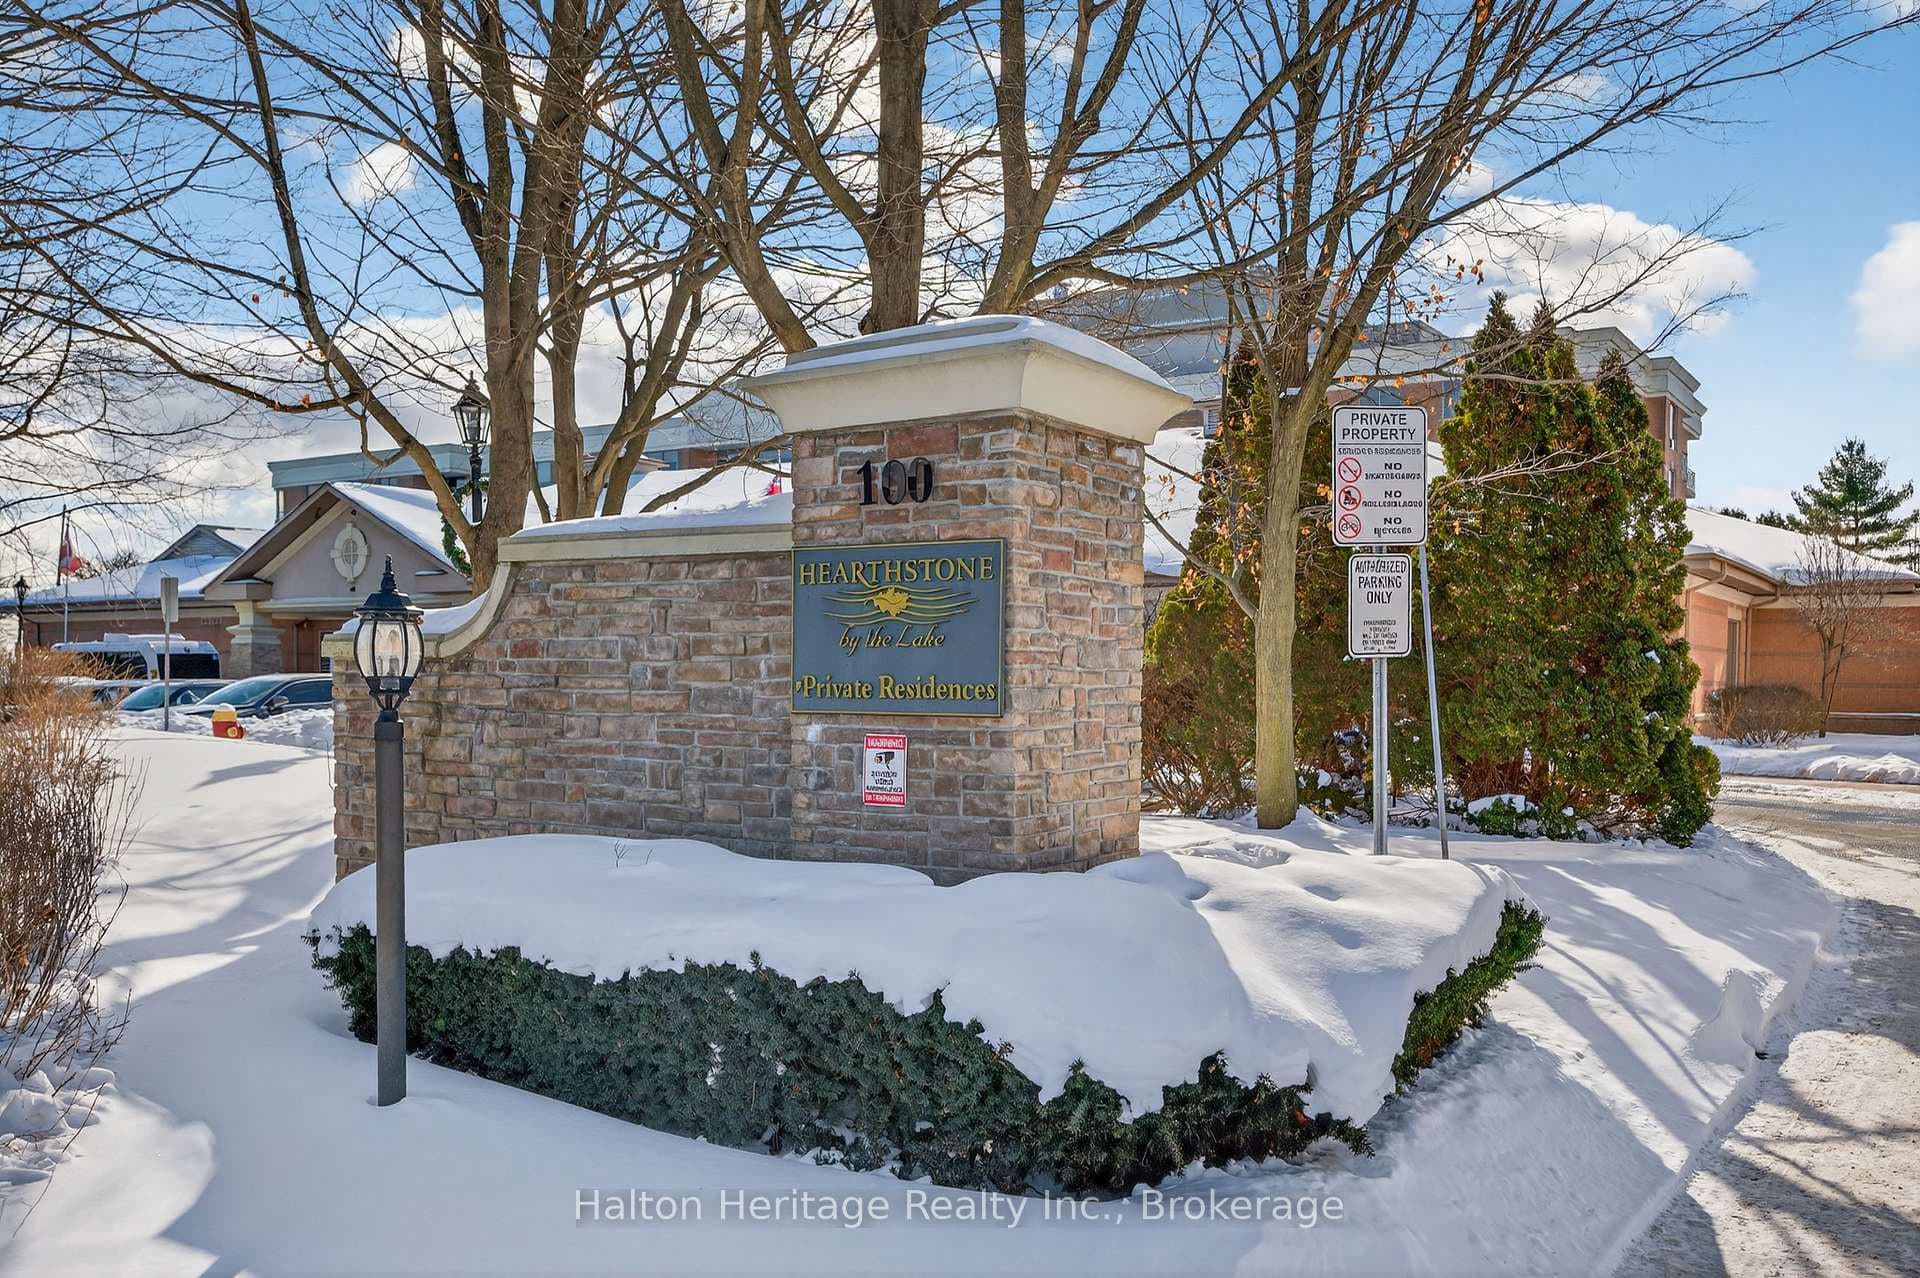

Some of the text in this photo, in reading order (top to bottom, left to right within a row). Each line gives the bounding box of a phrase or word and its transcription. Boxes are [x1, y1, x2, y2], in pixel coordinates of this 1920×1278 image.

[1351, 413, 1407, 425] PRIVATE
[1342, 428, 1416, 440] PROPERTY
[1384, 462, 1402, 471] NO
[856, 456, 935, 506] 100
[1384, 490, 1402, 499] NO
[1383, 517, 1402, 525] NO
[799, 557, 995, 587] HEARTHSTONE
[1355, 560, 1407, 573] AUTHORIZED
[1358, 576, 1402, 589] PARKING
[1366, 591, 1393, 604] ONLY
[839, 624, 946, 657] by the Lake
[796, 673, 996, 702] Private Residences
